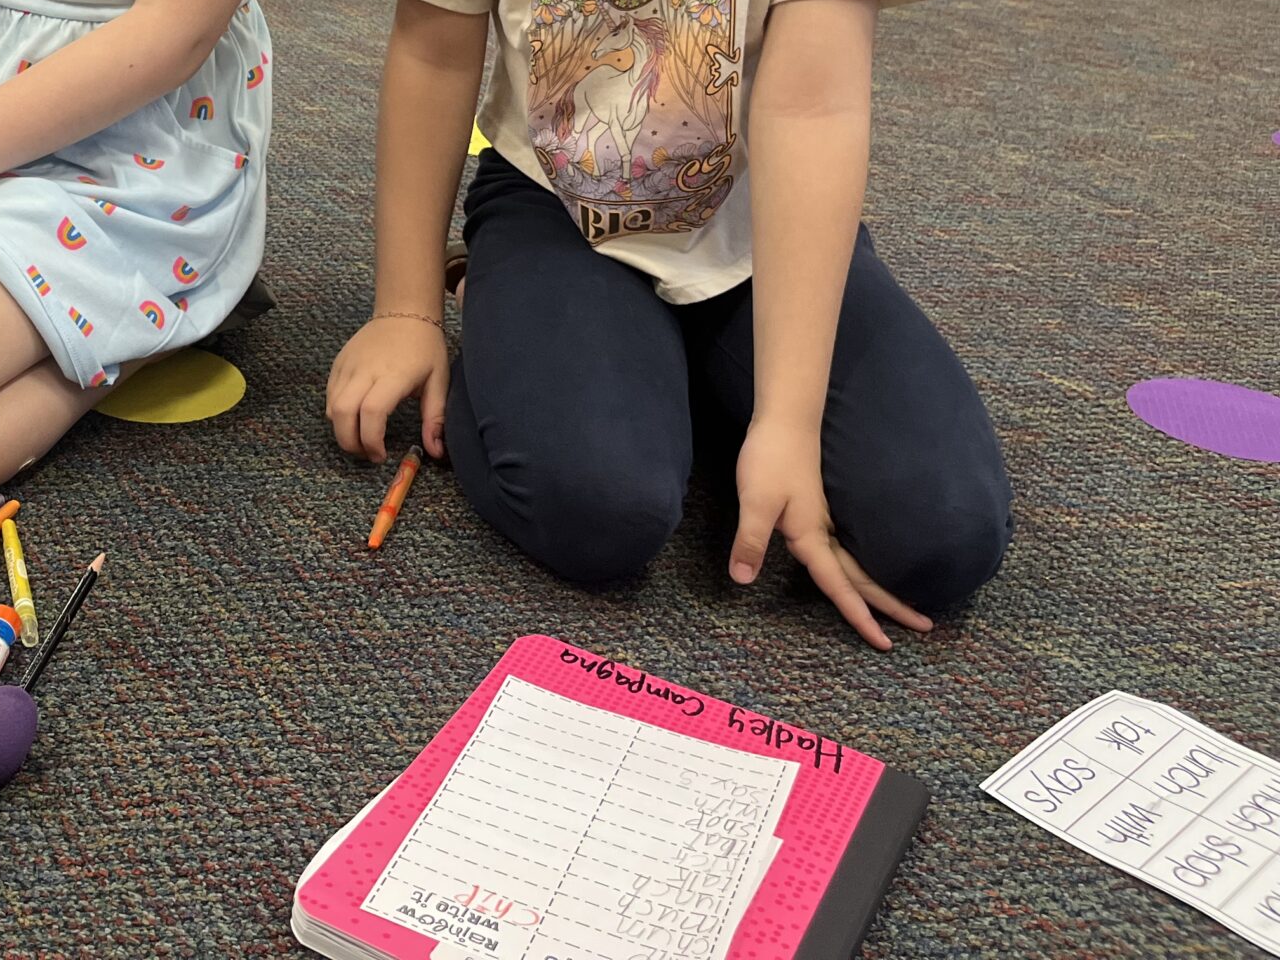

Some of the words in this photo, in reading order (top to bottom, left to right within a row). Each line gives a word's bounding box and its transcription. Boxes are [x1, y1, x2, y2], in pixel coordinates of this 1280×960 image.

[579, 203, 652, 240] BIG
[559, 647, 706, 717] Campagna
[728, 706, 845, 774] Hadley
[1096, 715, 1157, 756] talk
[1024, 758, 1096, 813] says
[1154, 744, 1241, 799] lunch
[1096, 802, 1163, 847] with
[1165, 834, 1249, 888] shop
[410, 890, 434, 909] it
[617, 891, 721, 934] much
[396, 904, 500, 951] Rainbow
